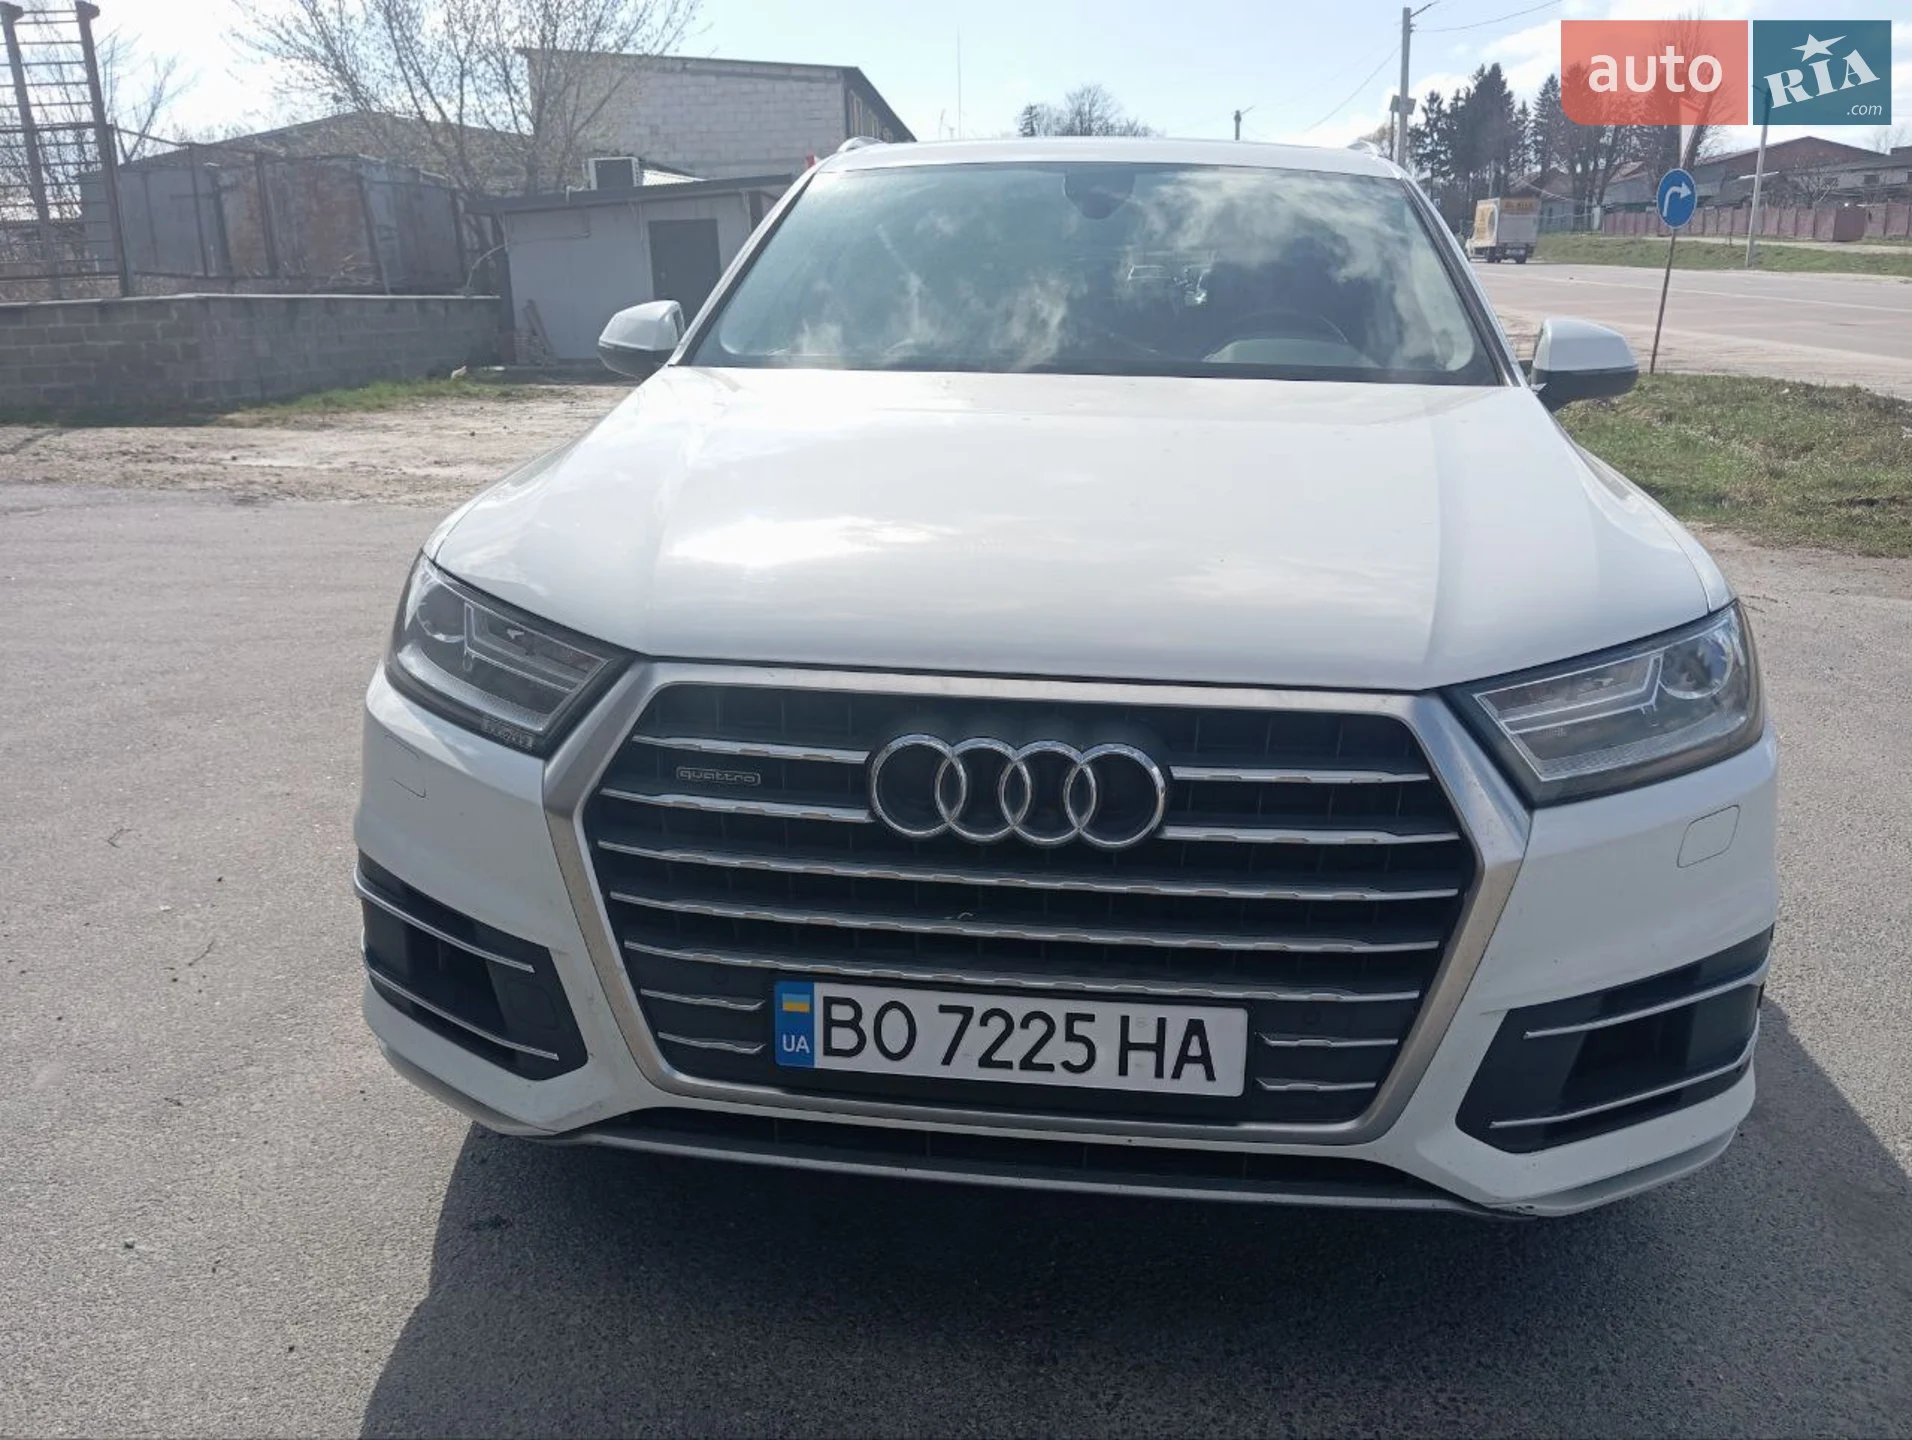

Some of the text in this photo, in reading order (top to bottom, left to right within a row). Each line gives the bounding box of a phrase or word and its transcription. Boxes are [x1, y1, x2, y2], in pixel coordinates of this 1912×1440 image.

[680, 769, 756, 783] quattro
[782, 1034, 811, 1055] UA
[822, 995, 1217, 1082] BO 7225 HA
